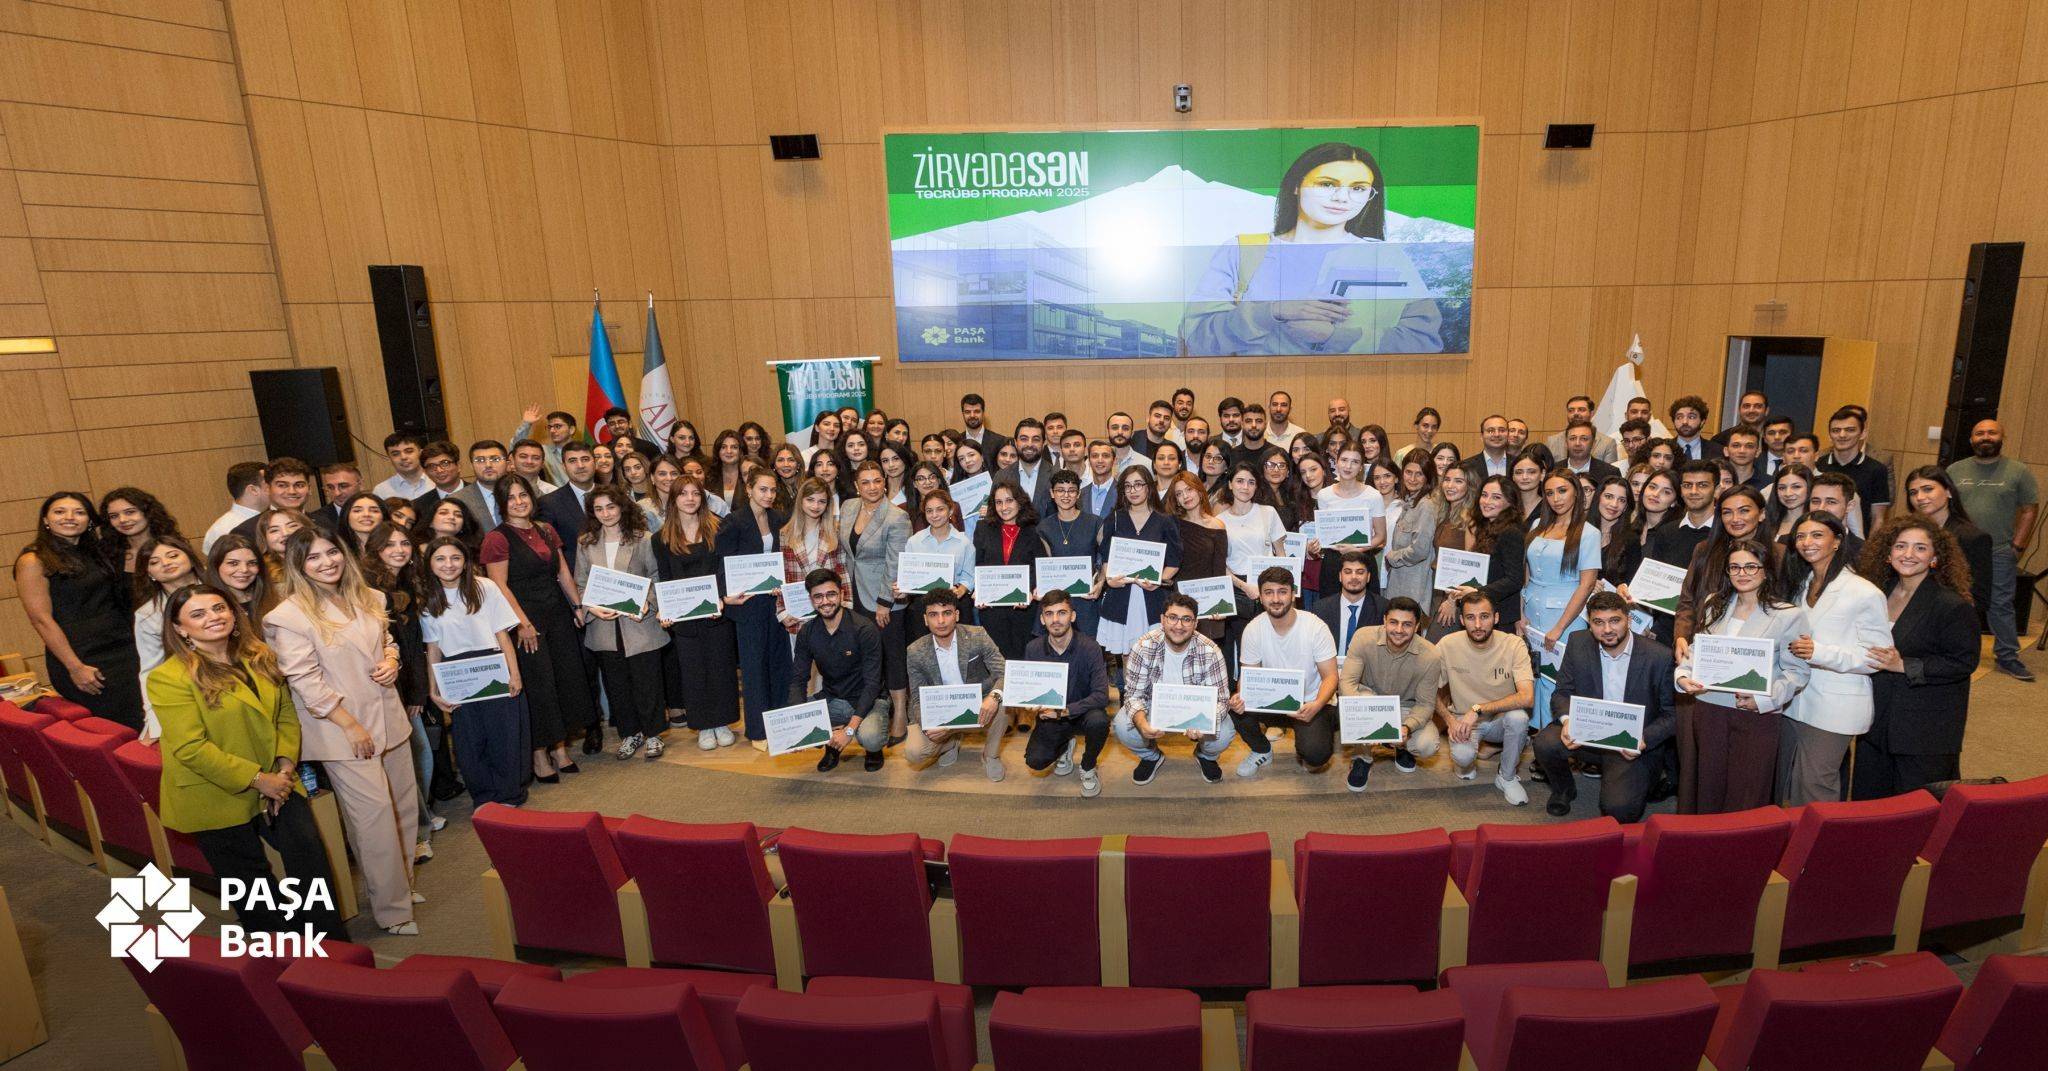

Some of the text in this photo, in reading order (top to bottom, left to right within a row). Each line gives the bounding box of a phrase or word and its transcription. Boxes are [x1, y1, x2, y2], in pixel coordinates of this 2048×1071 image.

[982, 188, 1053, 198] PROQRAMI
[1056, 187, 1090, 197] 2025
[953, 327, 986, 336] PAŞA
[1730, 647, 1766, 658] PARTICIPATION
[1604, 709, 1638, 721] PARTICIPATION
